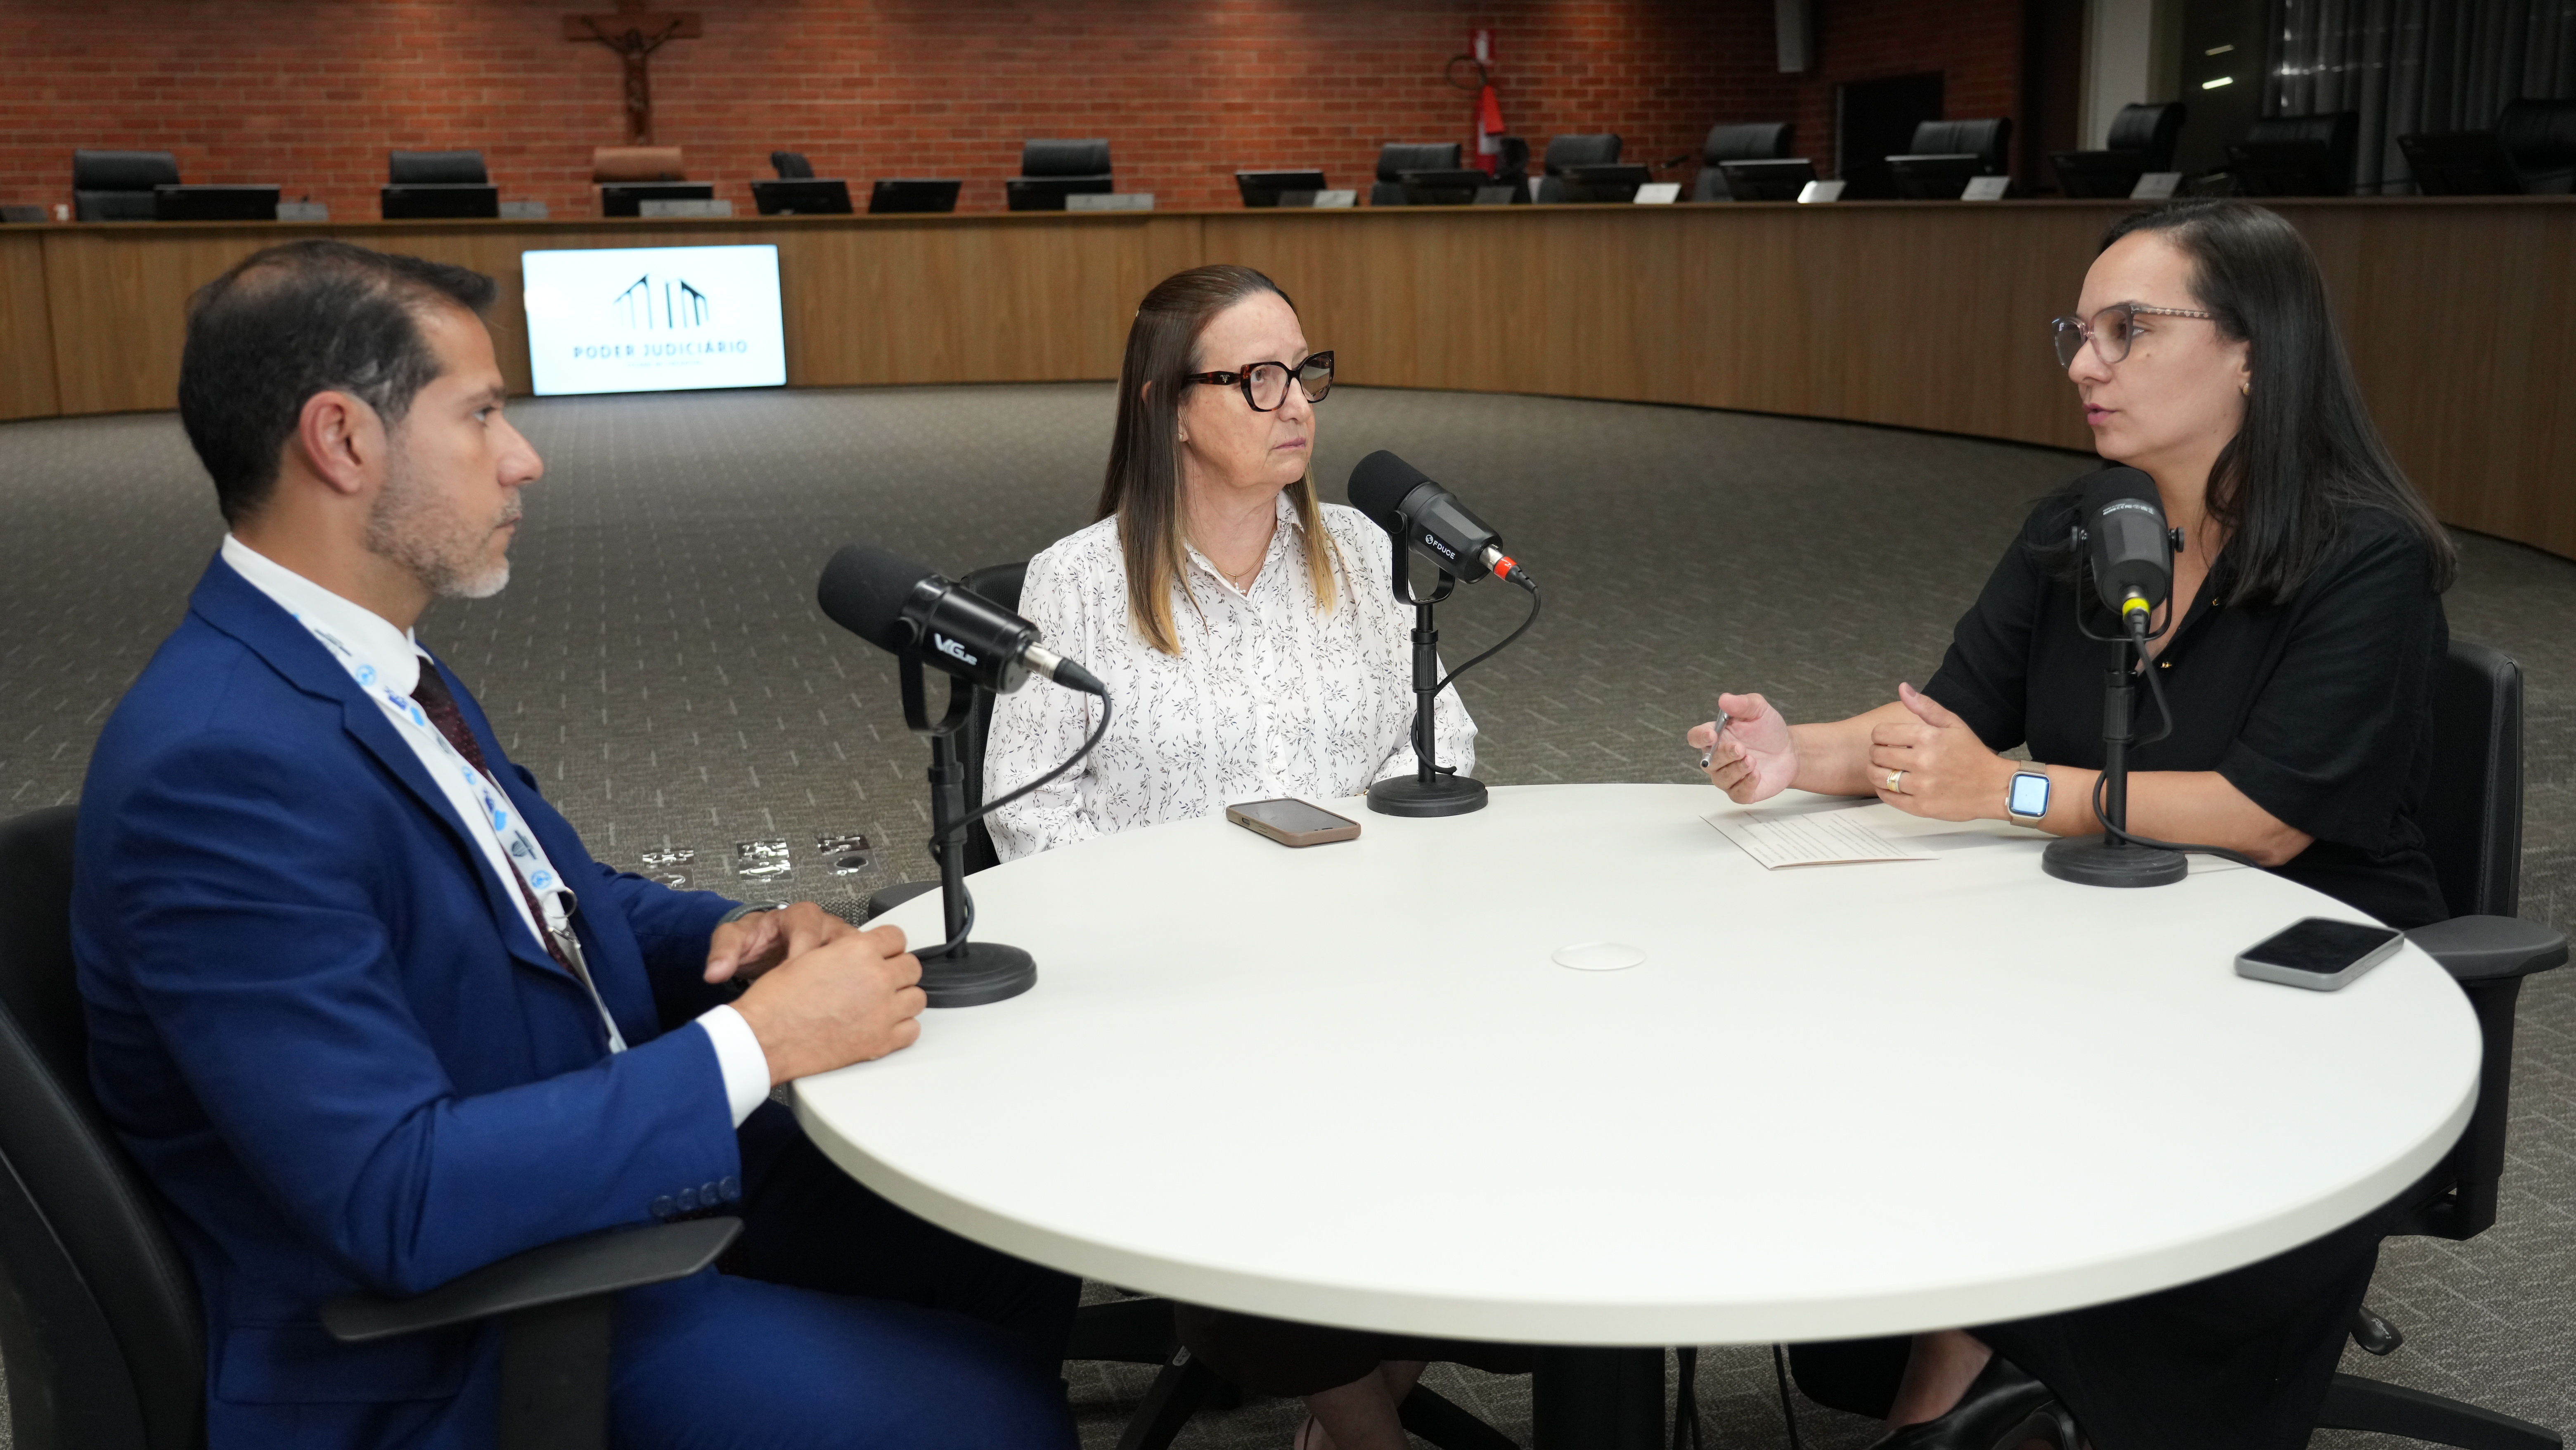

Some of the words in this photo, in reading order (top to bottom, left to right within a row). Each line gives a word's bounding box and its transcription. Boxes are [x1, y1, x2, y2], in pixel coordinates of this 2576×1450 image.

[574, 344, 634, 358] PODER
[644, 339, 747, 356] JUDICIÁRIO
[1433, 540, 1455, 559] FDUCE
